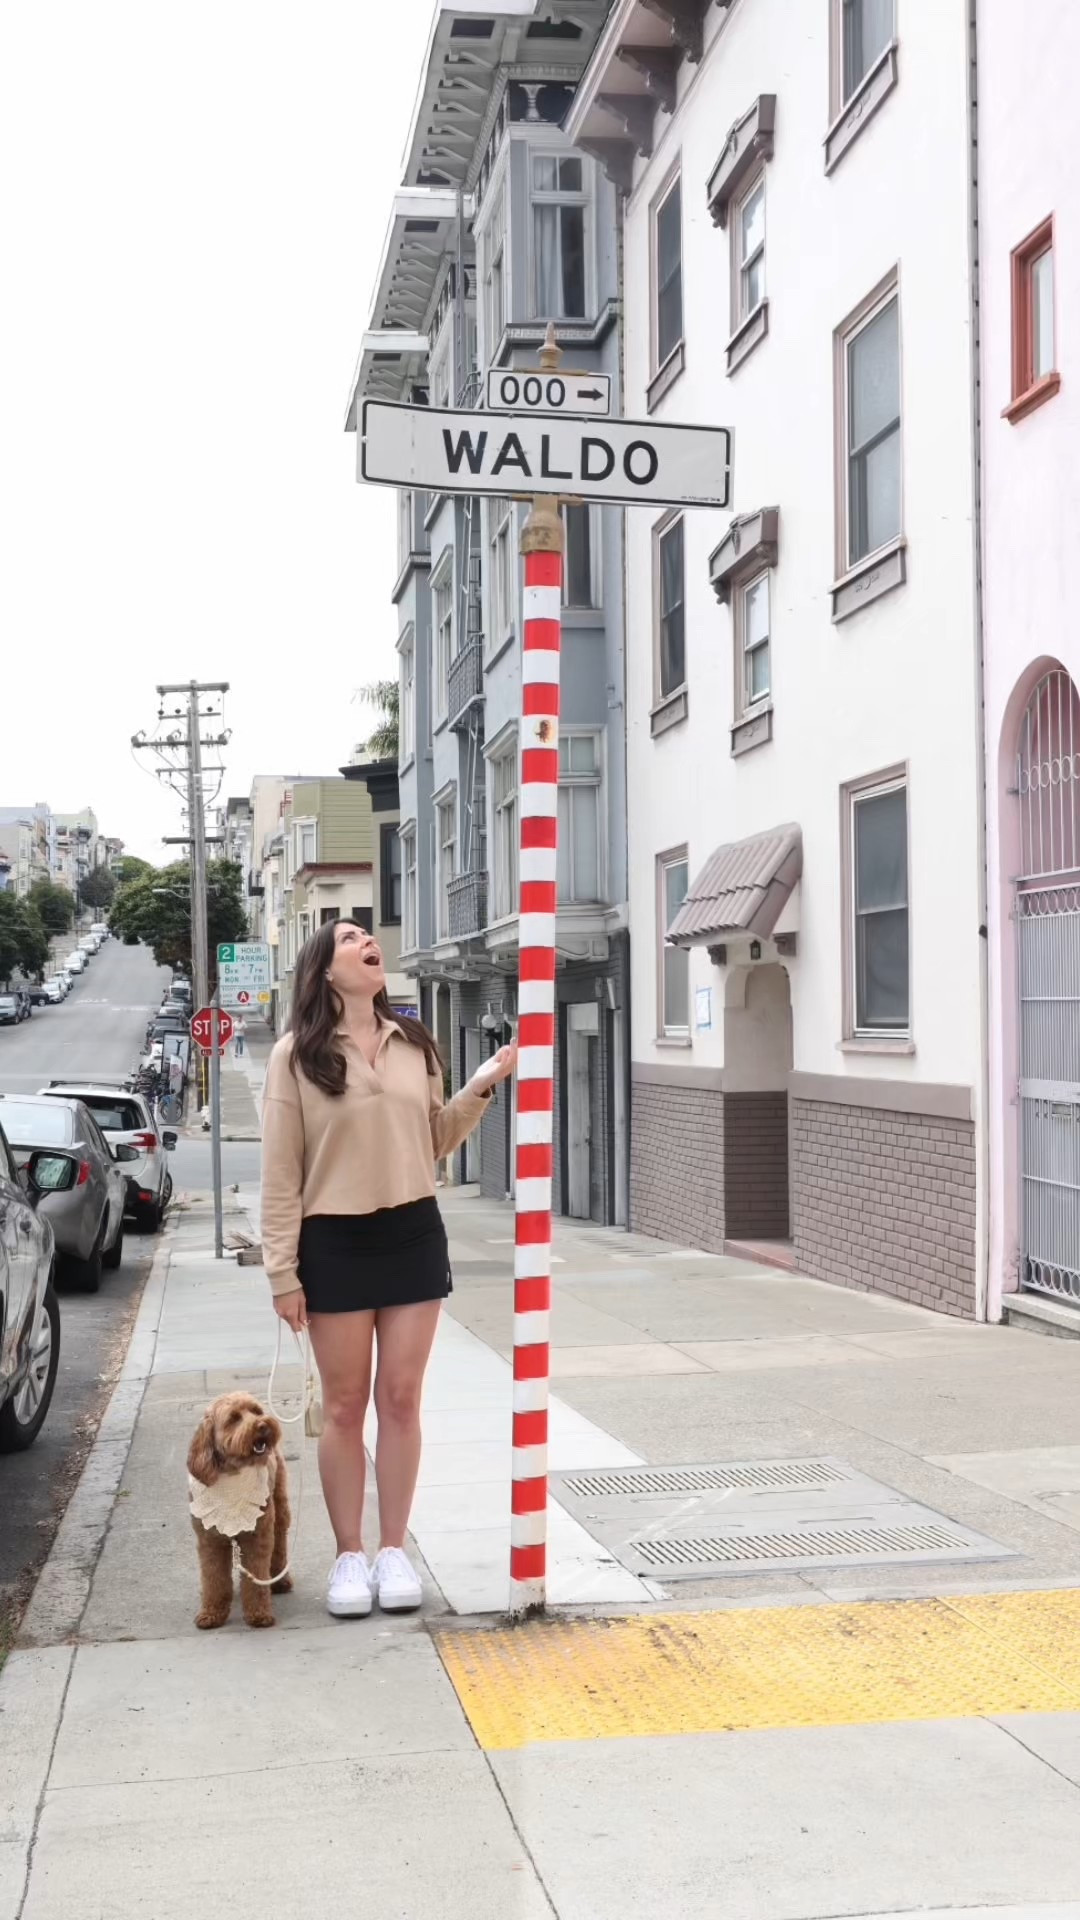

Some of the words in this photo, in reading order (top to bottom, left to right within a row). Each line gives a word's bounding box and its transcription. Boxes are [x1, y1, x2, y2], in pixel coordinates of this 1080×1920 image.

[500, 376, 566, 407] 000
[442, 428, 659, 486] WALDO
[222, 946, 231, 960] 2
[241, 946, 262, 954] HOUR
[236, 954, 268, 962] PARKING
[253, 975, 265, 983] FRI
[193, 1019, 231, 1036] STP
